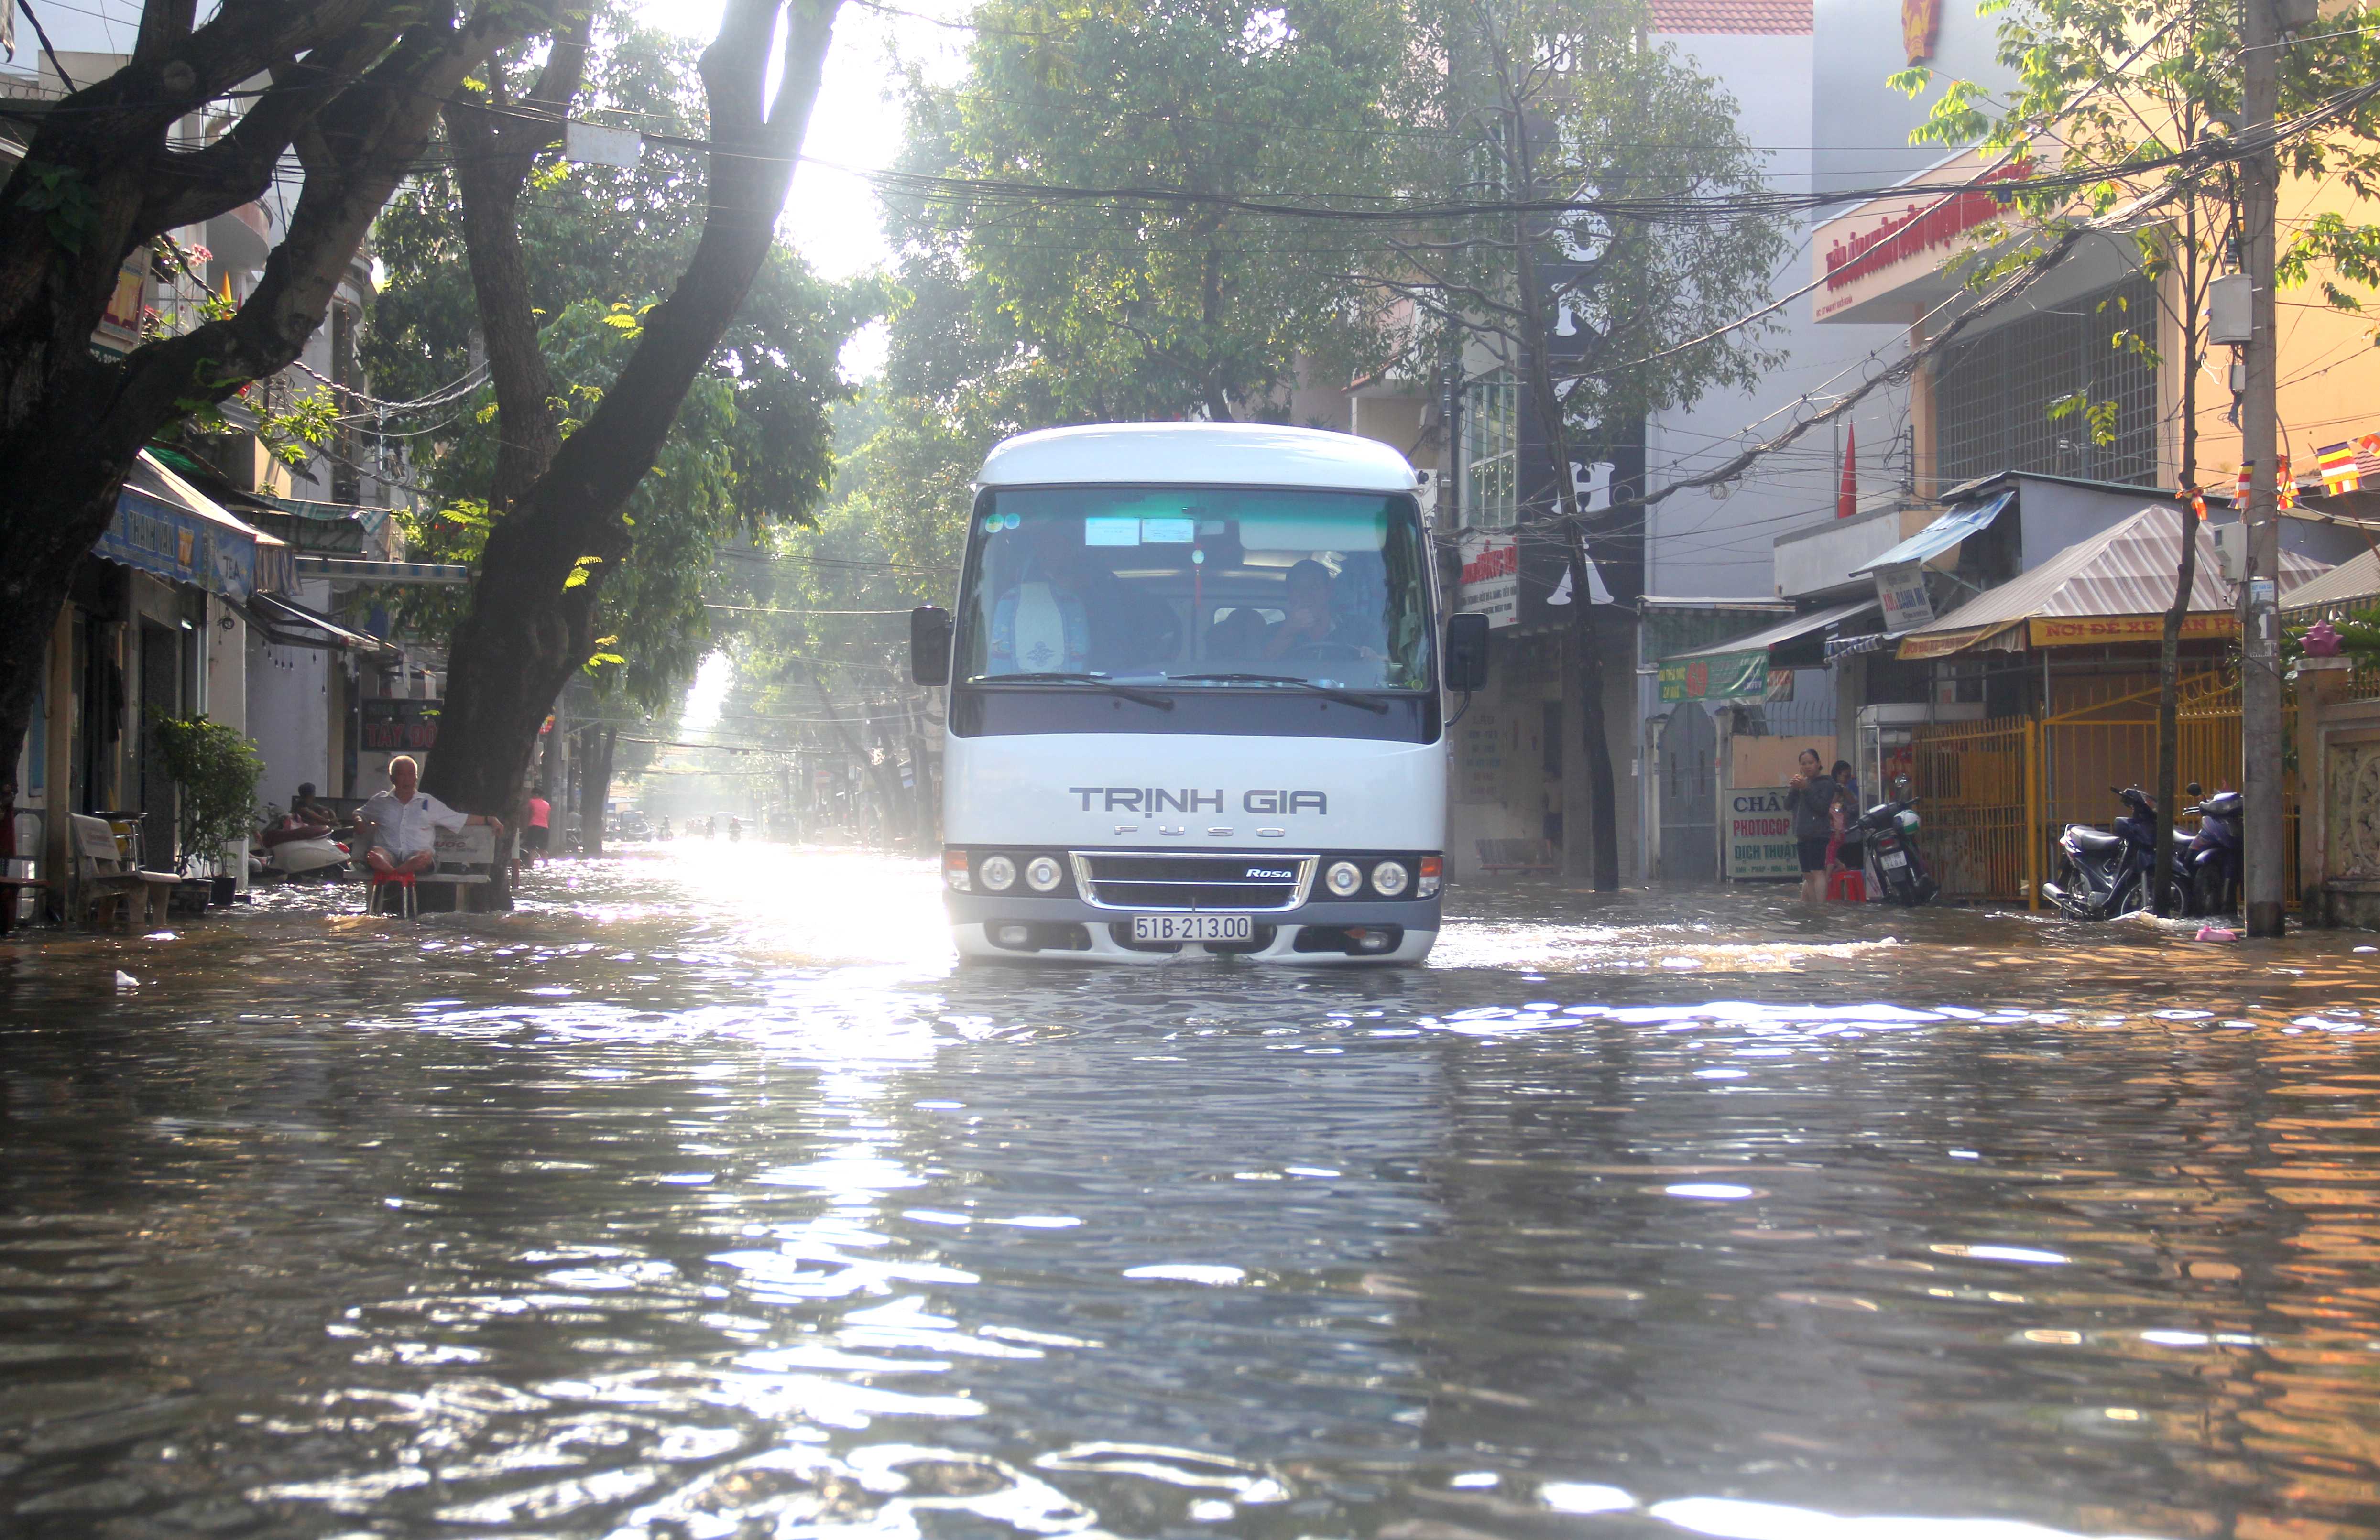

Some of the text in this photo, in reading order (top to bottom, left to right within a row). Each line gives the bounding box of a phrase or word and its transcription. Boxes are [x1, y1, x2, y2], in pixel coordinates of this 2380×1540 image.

[222, 555, 239, 580] TEA
[2046, 623, 2085, 637] NƠI
[2126, 621, 2158, 633] XE
[1686, 662, 1708, 697] 69
[1069, 787, 1327, 818] TRỊNH GIA
[1733, 792, 1788, 812] CHÂ
[1114, 825, 1286, 837] FUSO
[1735, 845, 1760, 864] DỊCH
[1136, 917, 1248, 939] 51B-213.00
